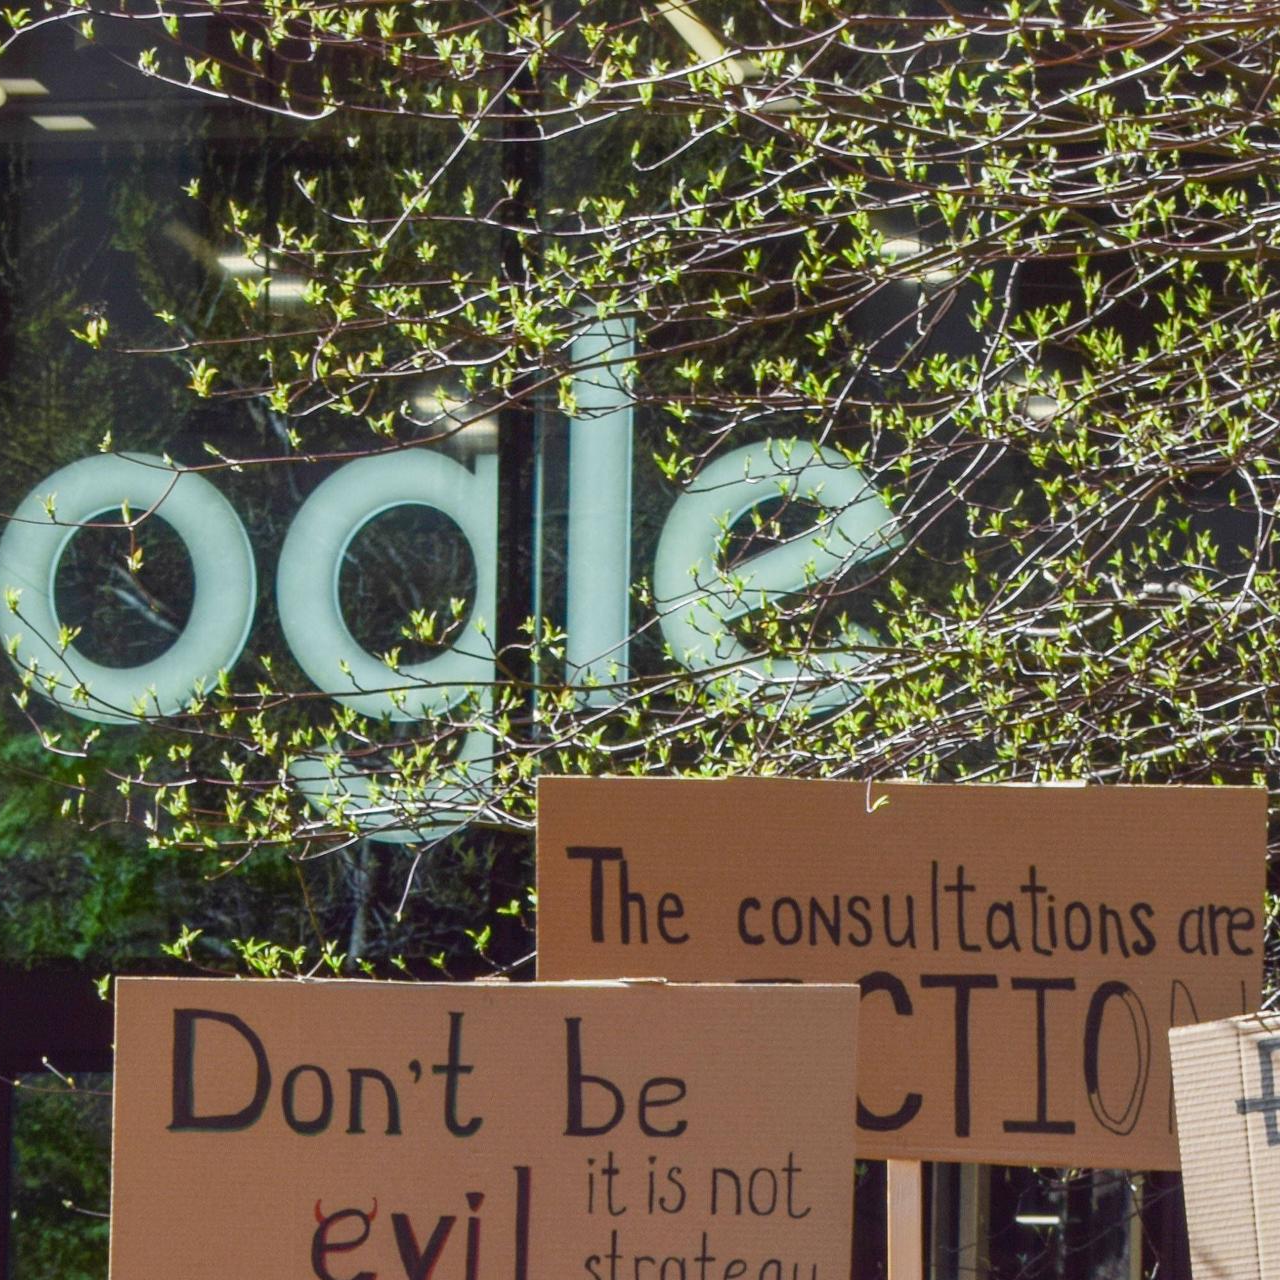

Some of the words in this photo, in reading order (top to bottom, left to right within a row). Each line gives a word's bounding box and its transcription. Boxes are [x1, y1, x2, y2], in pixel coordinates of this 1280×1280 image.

[566, 846, 690, 946] The
[737, 860, 1157, 959] consultations
[1178, 903, 1255, 957] are
[166, 1008, 483, 1139] Don't
[563, 1016, 688, 1138] be
[586, 1150, 622, 1218] it
[647, 1155, 687, 1217] is
[709, 1152, 812, 1220] not
